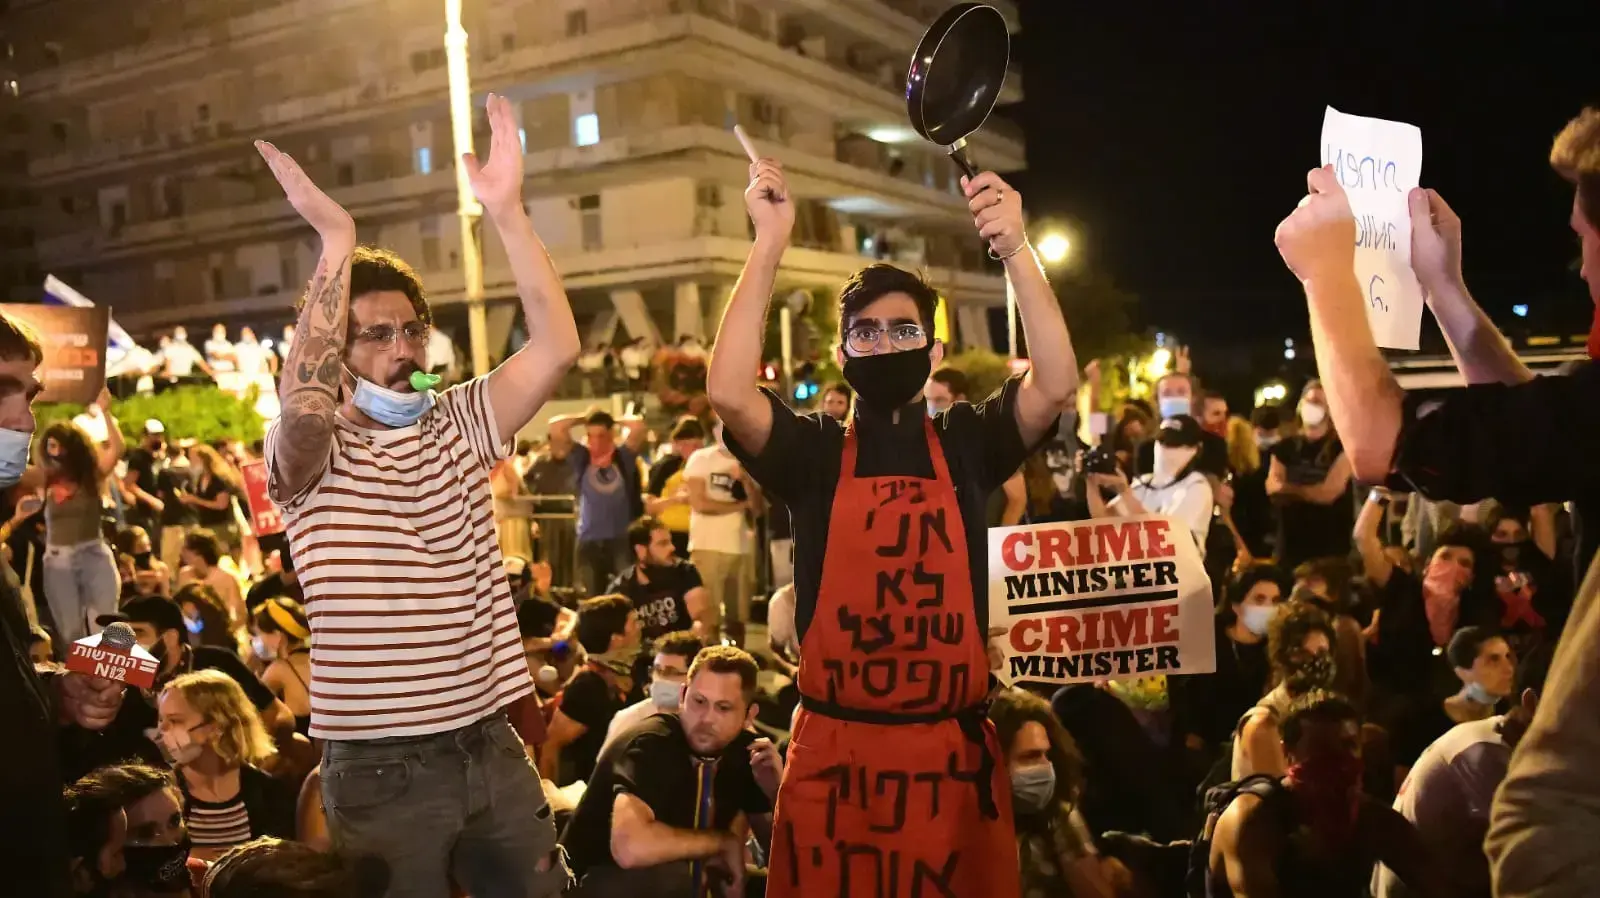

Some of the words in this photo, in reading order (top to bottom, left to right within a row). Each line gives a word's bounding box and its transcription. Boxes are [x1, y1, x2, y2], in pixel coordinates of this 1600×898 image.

[872, 479, 927, 507] ביבי
[863, 507, 954, 558] אני
[1001, 520, 1176, 571] CRIME
[876, 560, 945, 611] לא
[1004, 561, 1179, 600] MINISTER
[837, 604, 964, 654] שניצל
[1009, 604, 1179, 653] CRIME
[72, 645, 137, 669] החדשות
[94, 662, 127, 681] N12
[1009, 646, 1181, 679] MINISTER
[822, 657, 970, 713] תפסיק
